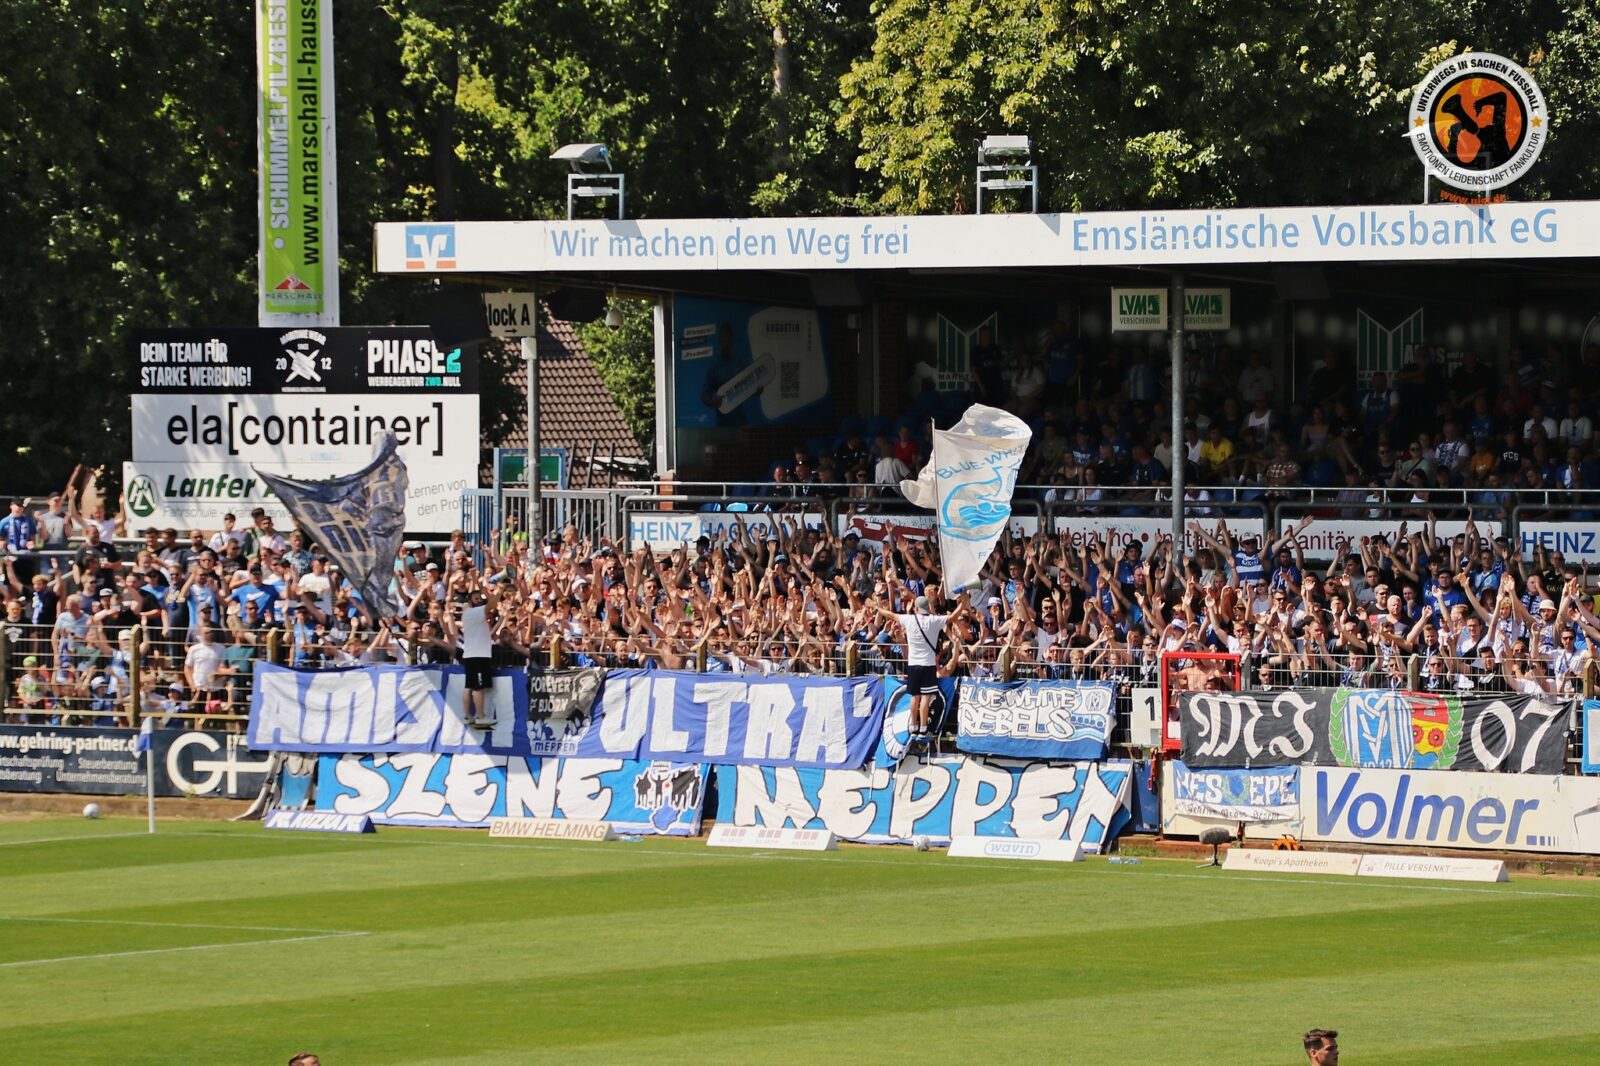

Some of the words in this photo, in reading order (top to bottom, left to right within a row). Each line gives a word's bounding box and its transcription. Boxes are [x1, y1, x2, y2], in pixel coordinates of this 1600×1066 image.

[1073, 214, 1299, 252] Emsländische
[1312, 209, 1496, 248] Volksbank
[1510, 207, 1558, 245] eG
[551, 229, 599, 258] Wir
[609, 228, 715, 258] machen
[725, 225, 776, 257] den
[787, 226, 851, 264] Weg
[861, 223, 910, 256] frei
[488, 303, 517, 326] lock
[521, 303, 531, 326] A
[140, 343, 168, 363] DEIN
[169, 343, 203, 363] TEAM
[204, 339, 229, 363] FÜR
[276, 358, 287, 370] 20
[320, 357, 332, 370] 12
[141, 366, 188, 387] STARKE
[189, 366, 252, 387] WERBUNG!
[164, 474, 258, 498] Lanfer
[408, 483, 445, 499] Lernen
[446, 480, 467, 492] von
[417, 503, 438, 517] den
[630, 521, 693, 542] HEINZ
[1522, 532, 1596, 553] HEINZ
[960, 684, 1004, 708] BLUE
[1004, 687, 1078, 709] WHITE
[957, 701, 1076, 740] REBELS
[1470, 700, 1561, 772] 07
[78, 758, 138, 773] Steuerberatung
[56, 770, 147, 787] Unternehmensberatung
[334, 753, 614, 823] SZENE
[734, 756, 1127, 840] MEPPEN
[491, 821, 531, 835] BMW
[533, 823, 606, 839] HELMING
[990, 842, 1034, 854] wavin
[1284, 858, 1329, 868] Apotheken
[1384, 862, 1405, 871] PILLE
[1408, 863, 1450, 873] VERSENKT
